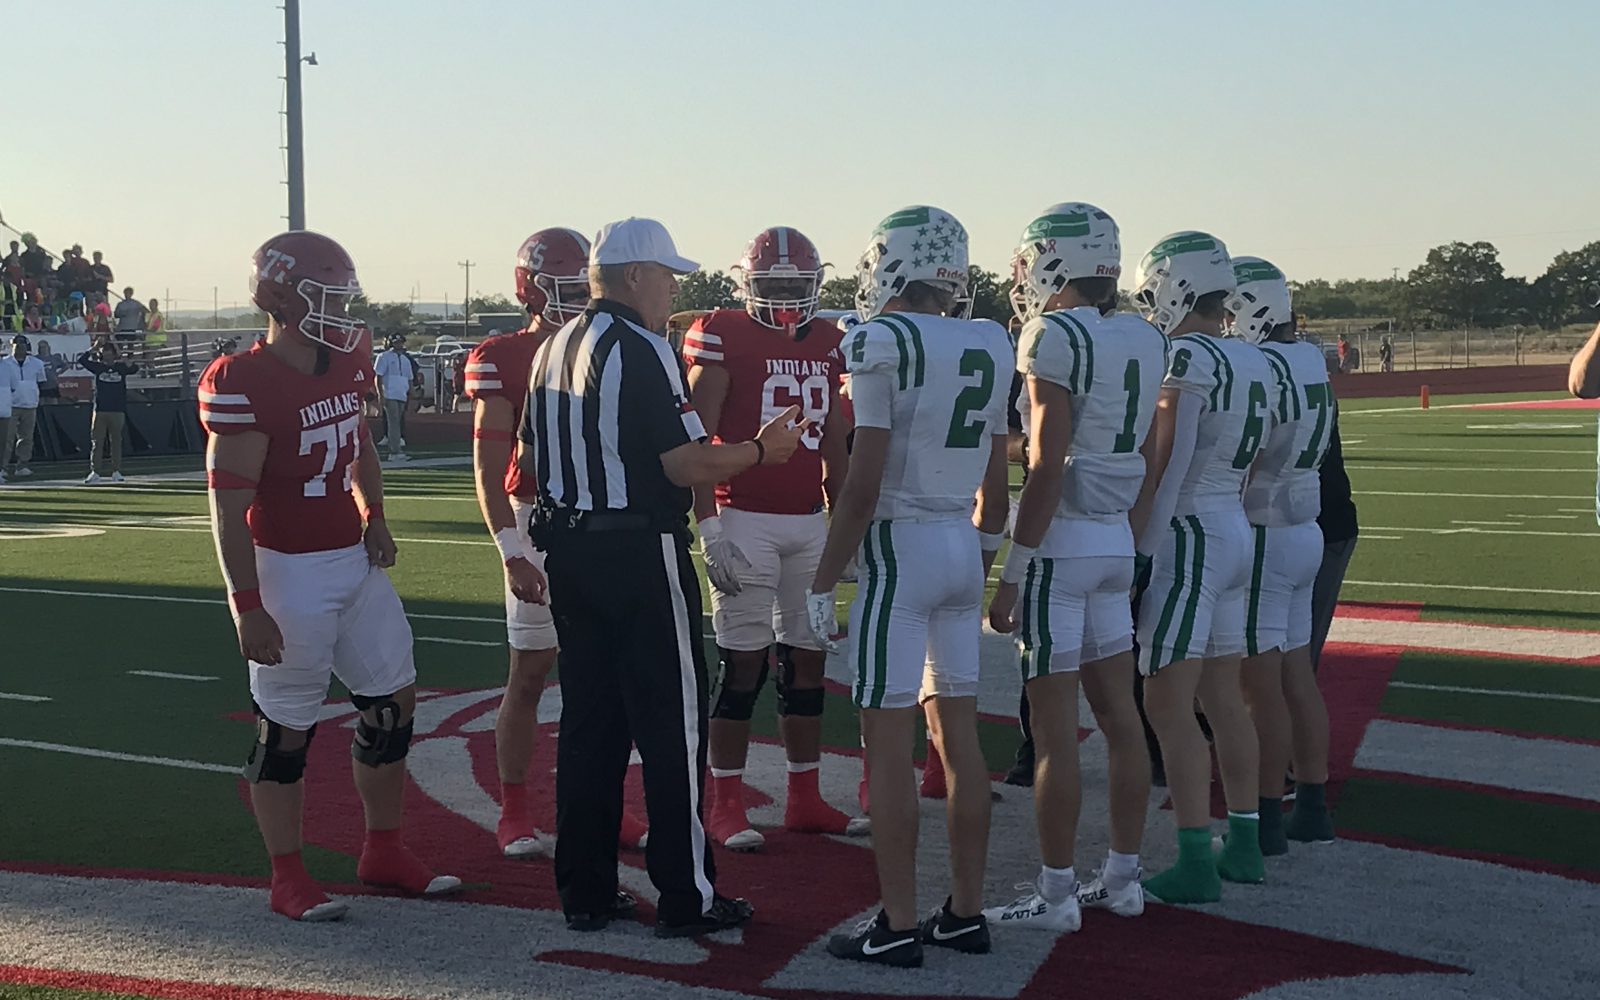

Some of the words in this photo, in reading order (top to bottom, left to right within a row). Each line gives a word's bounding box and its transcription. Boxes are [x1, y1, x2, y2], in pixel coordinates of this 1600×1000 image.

[852, 331, 867, 362] 2
[1171, 347, 1192, 378] 6
[766, 359, 830, 376] INDIANS
[299, 392, 360, 427] INDIANS
[945, 349, 996, 448] 2
[1112, 359, 1141, 453] 1
[1232, 381, 1268, 469] 6
[299, 413, 360, 497] 77
[1001, 903, 1047, 920] BATTLE
